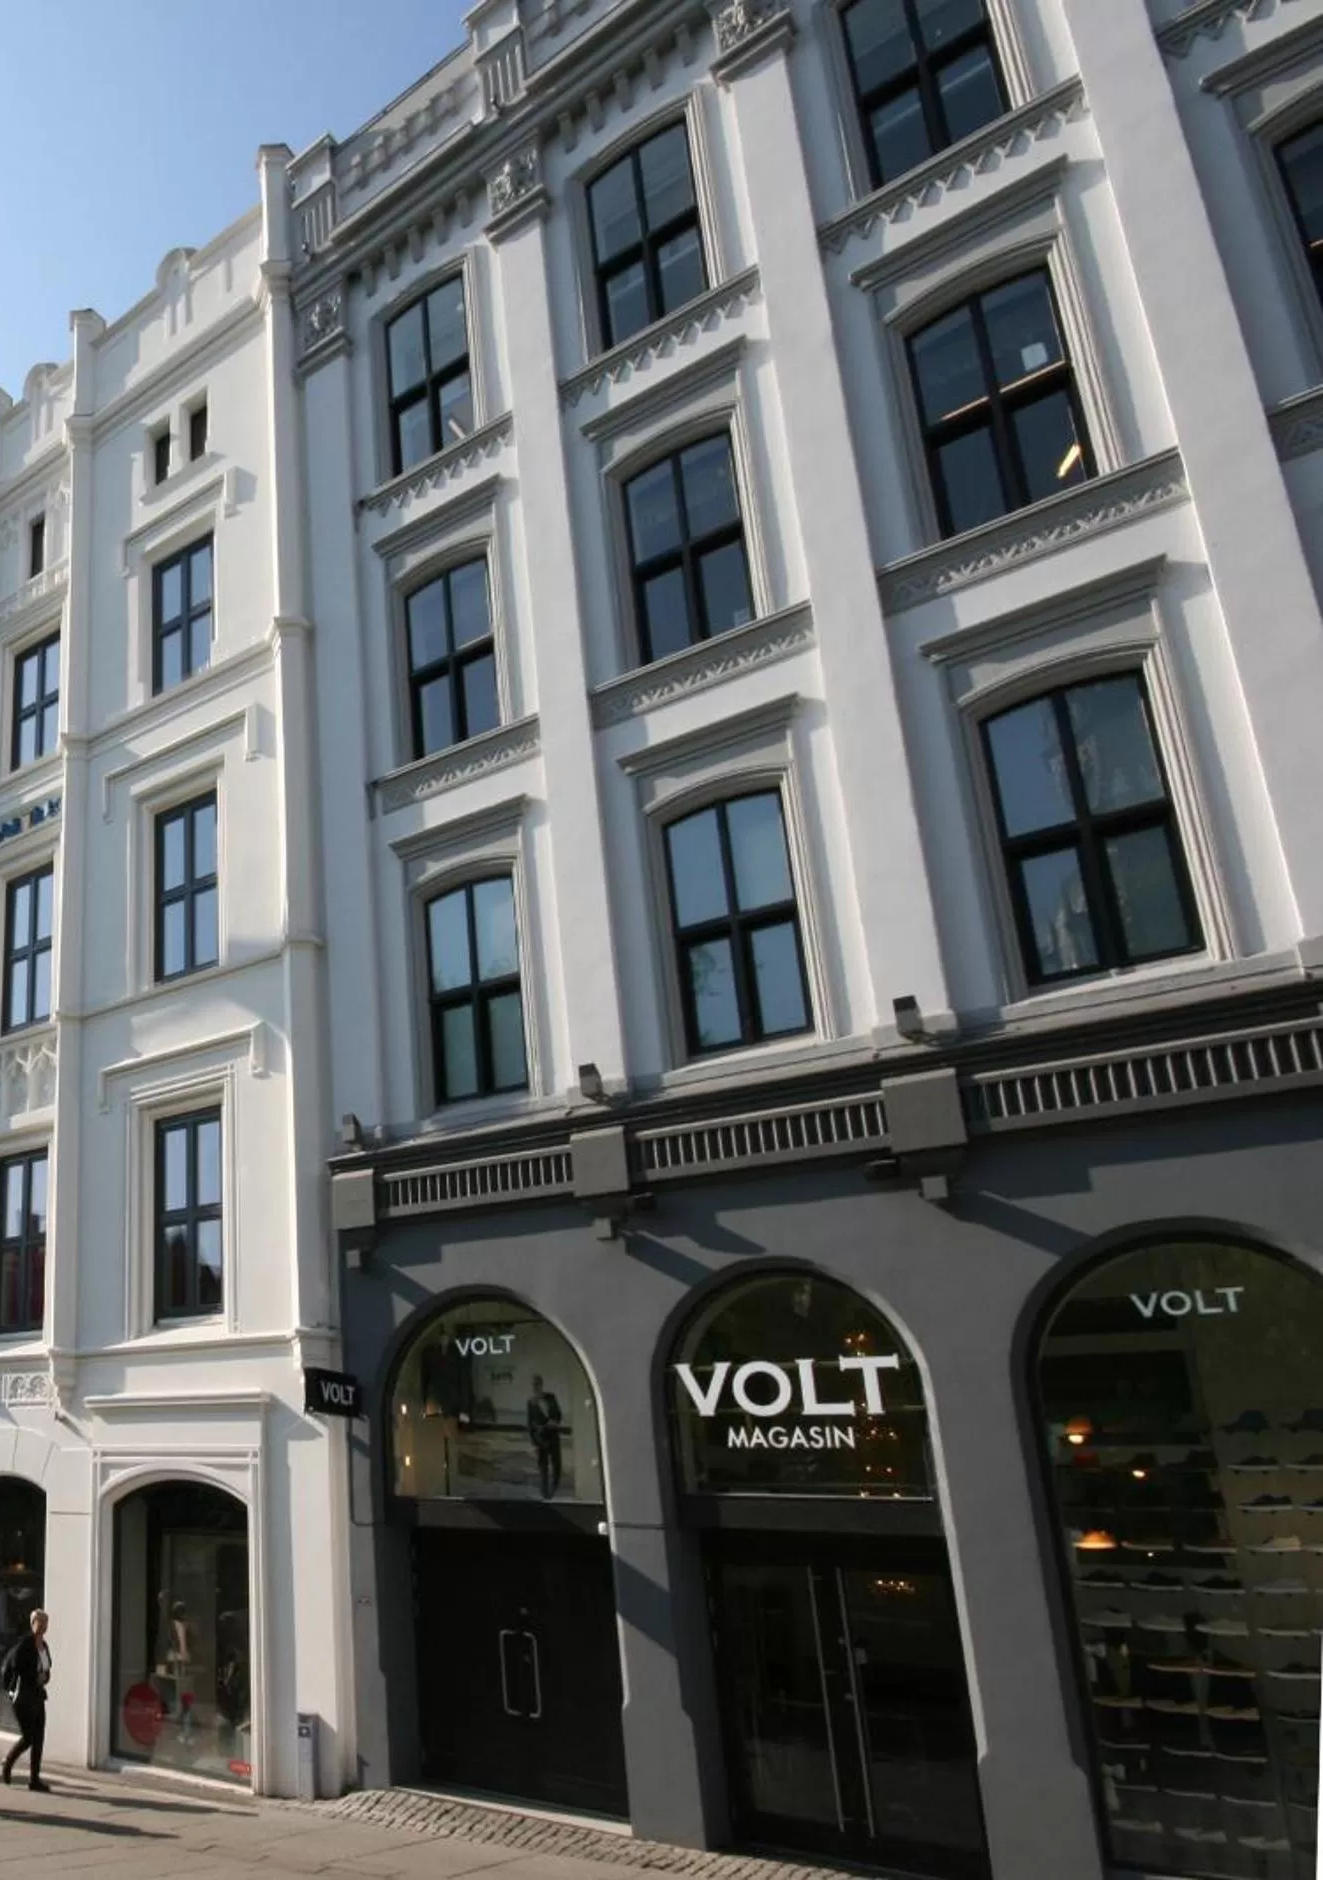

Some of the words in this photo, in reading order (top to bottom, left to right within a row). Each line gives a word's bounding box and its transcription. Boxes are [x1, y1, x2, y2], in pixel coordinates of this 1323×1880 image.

[1129, 1286, 1245, 1318] VOLT
[454, 1334, 516, 1357] VOLT
[320, 1380, 355, 1405] VOLT
[674, 1353, 900, 1417] VOLT
[728, 1425, 856, 1449] MAGASIN
